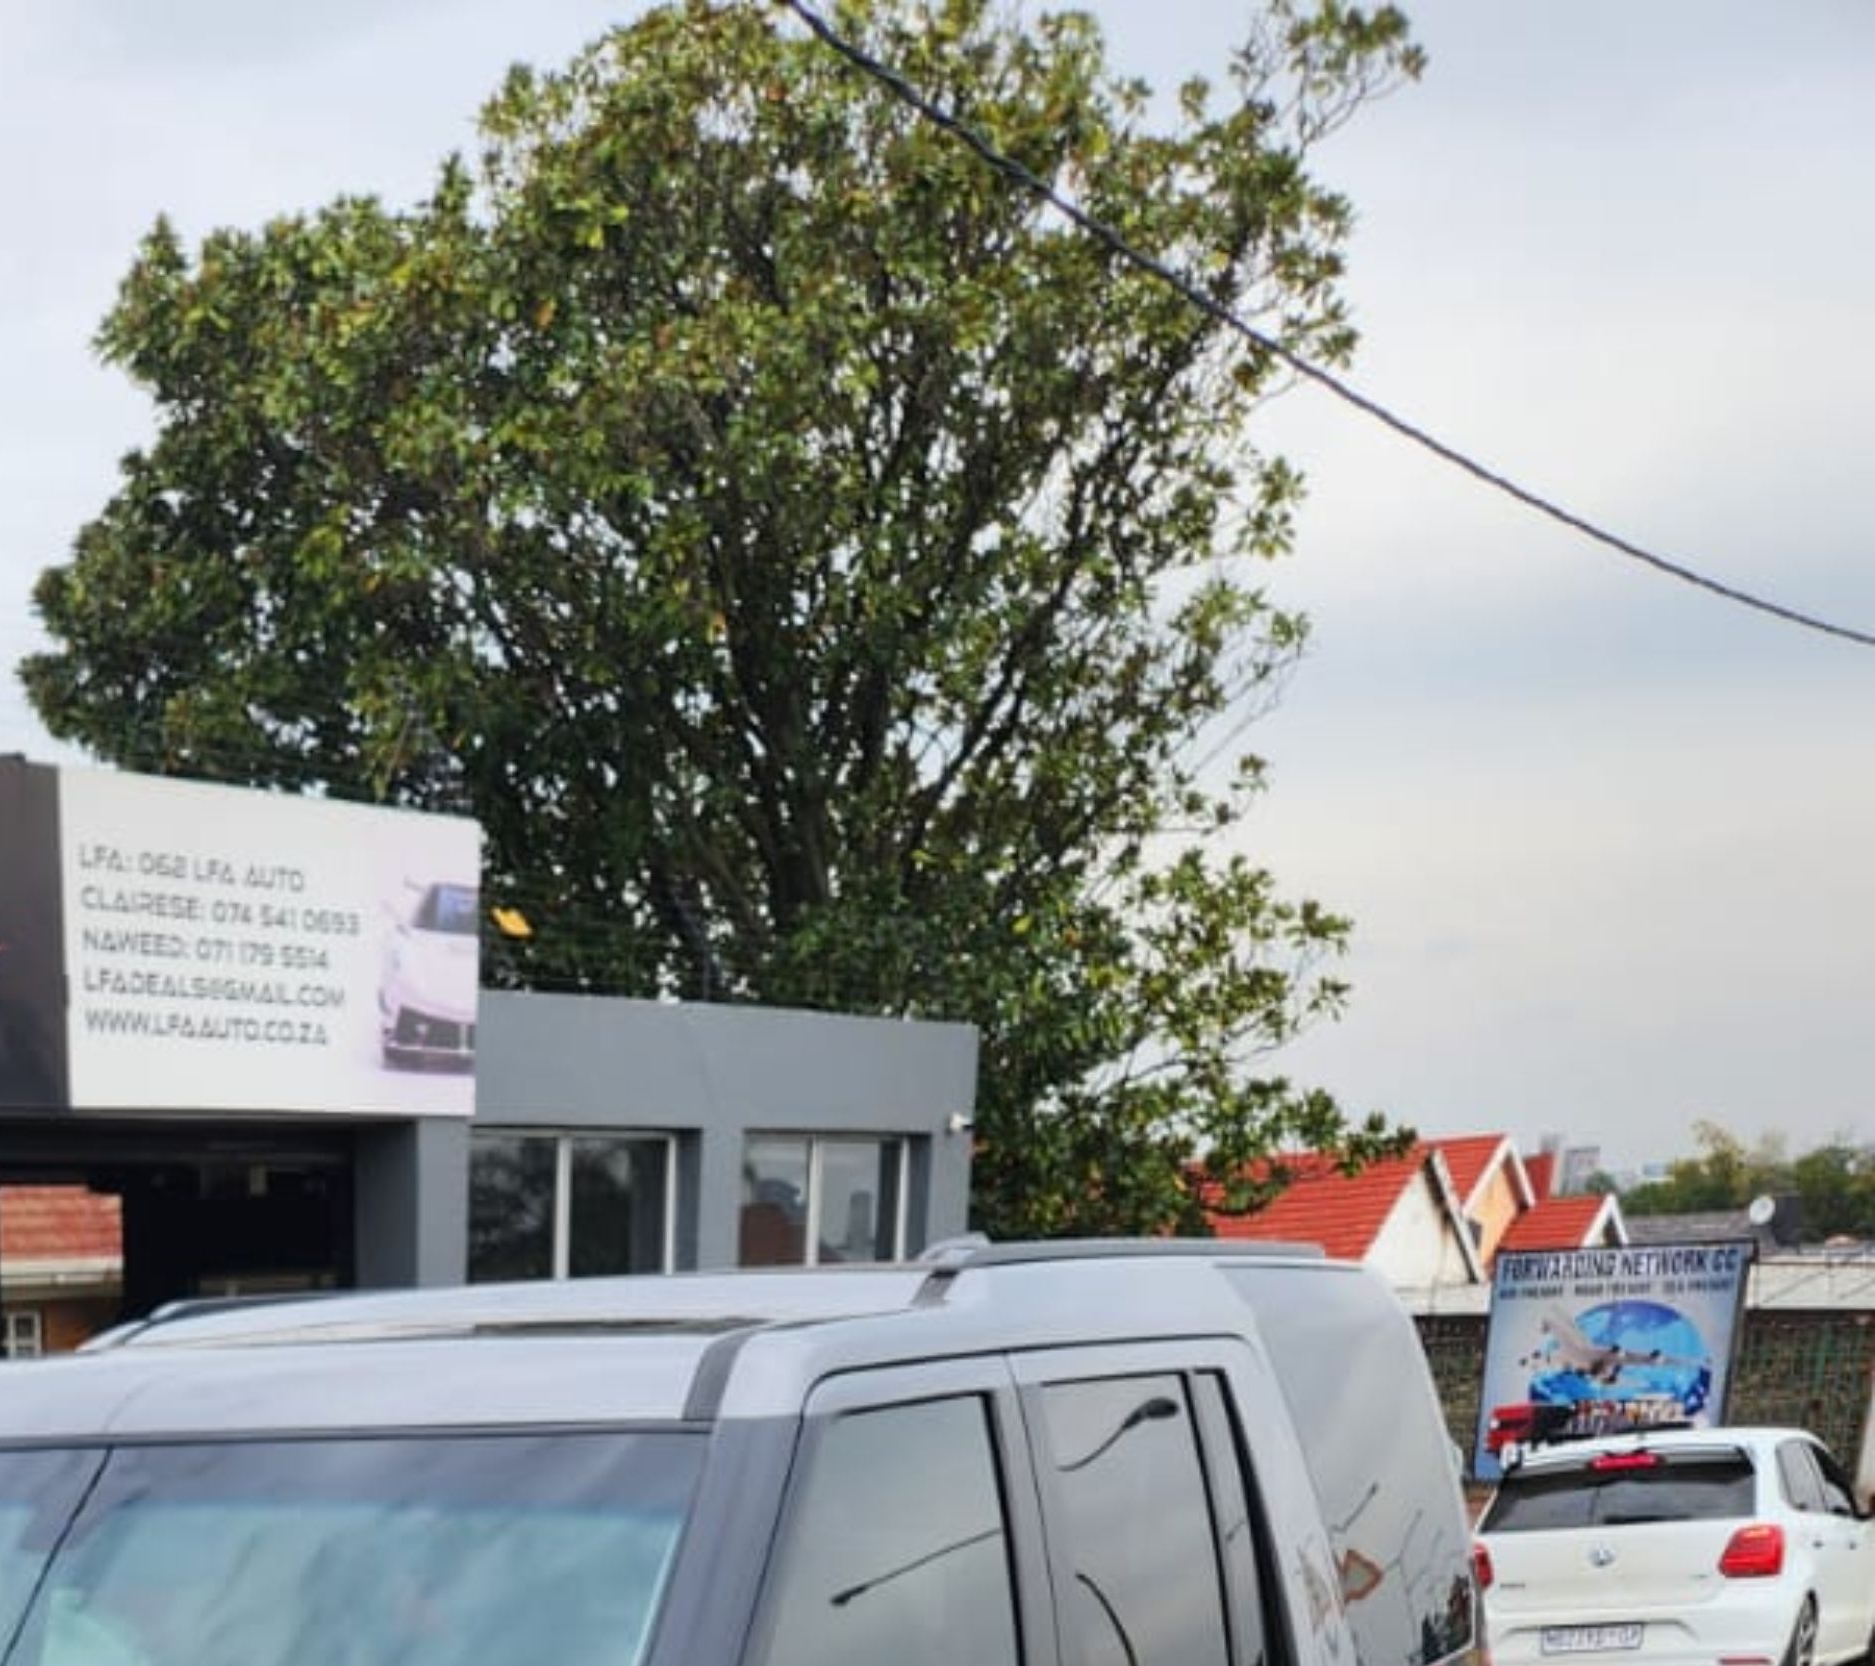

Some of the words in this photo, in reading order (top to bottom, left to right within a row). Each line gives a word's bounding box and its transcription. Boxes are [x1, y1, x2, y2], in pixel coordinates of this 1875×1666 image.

[79, 844, 132, 874] LFA:
[194, 859, 235, 886] LFA
[243, 867, 305, 893] AUTO
[211, 900, 253, 925] 074
[82, 929, 189, 961] NAWEED:
[196, 937, 232, 962] 071
[1501, 1252, 1616, 1283] FORWARDING
[1621, 1249, 1707, 1276] NETWORK
